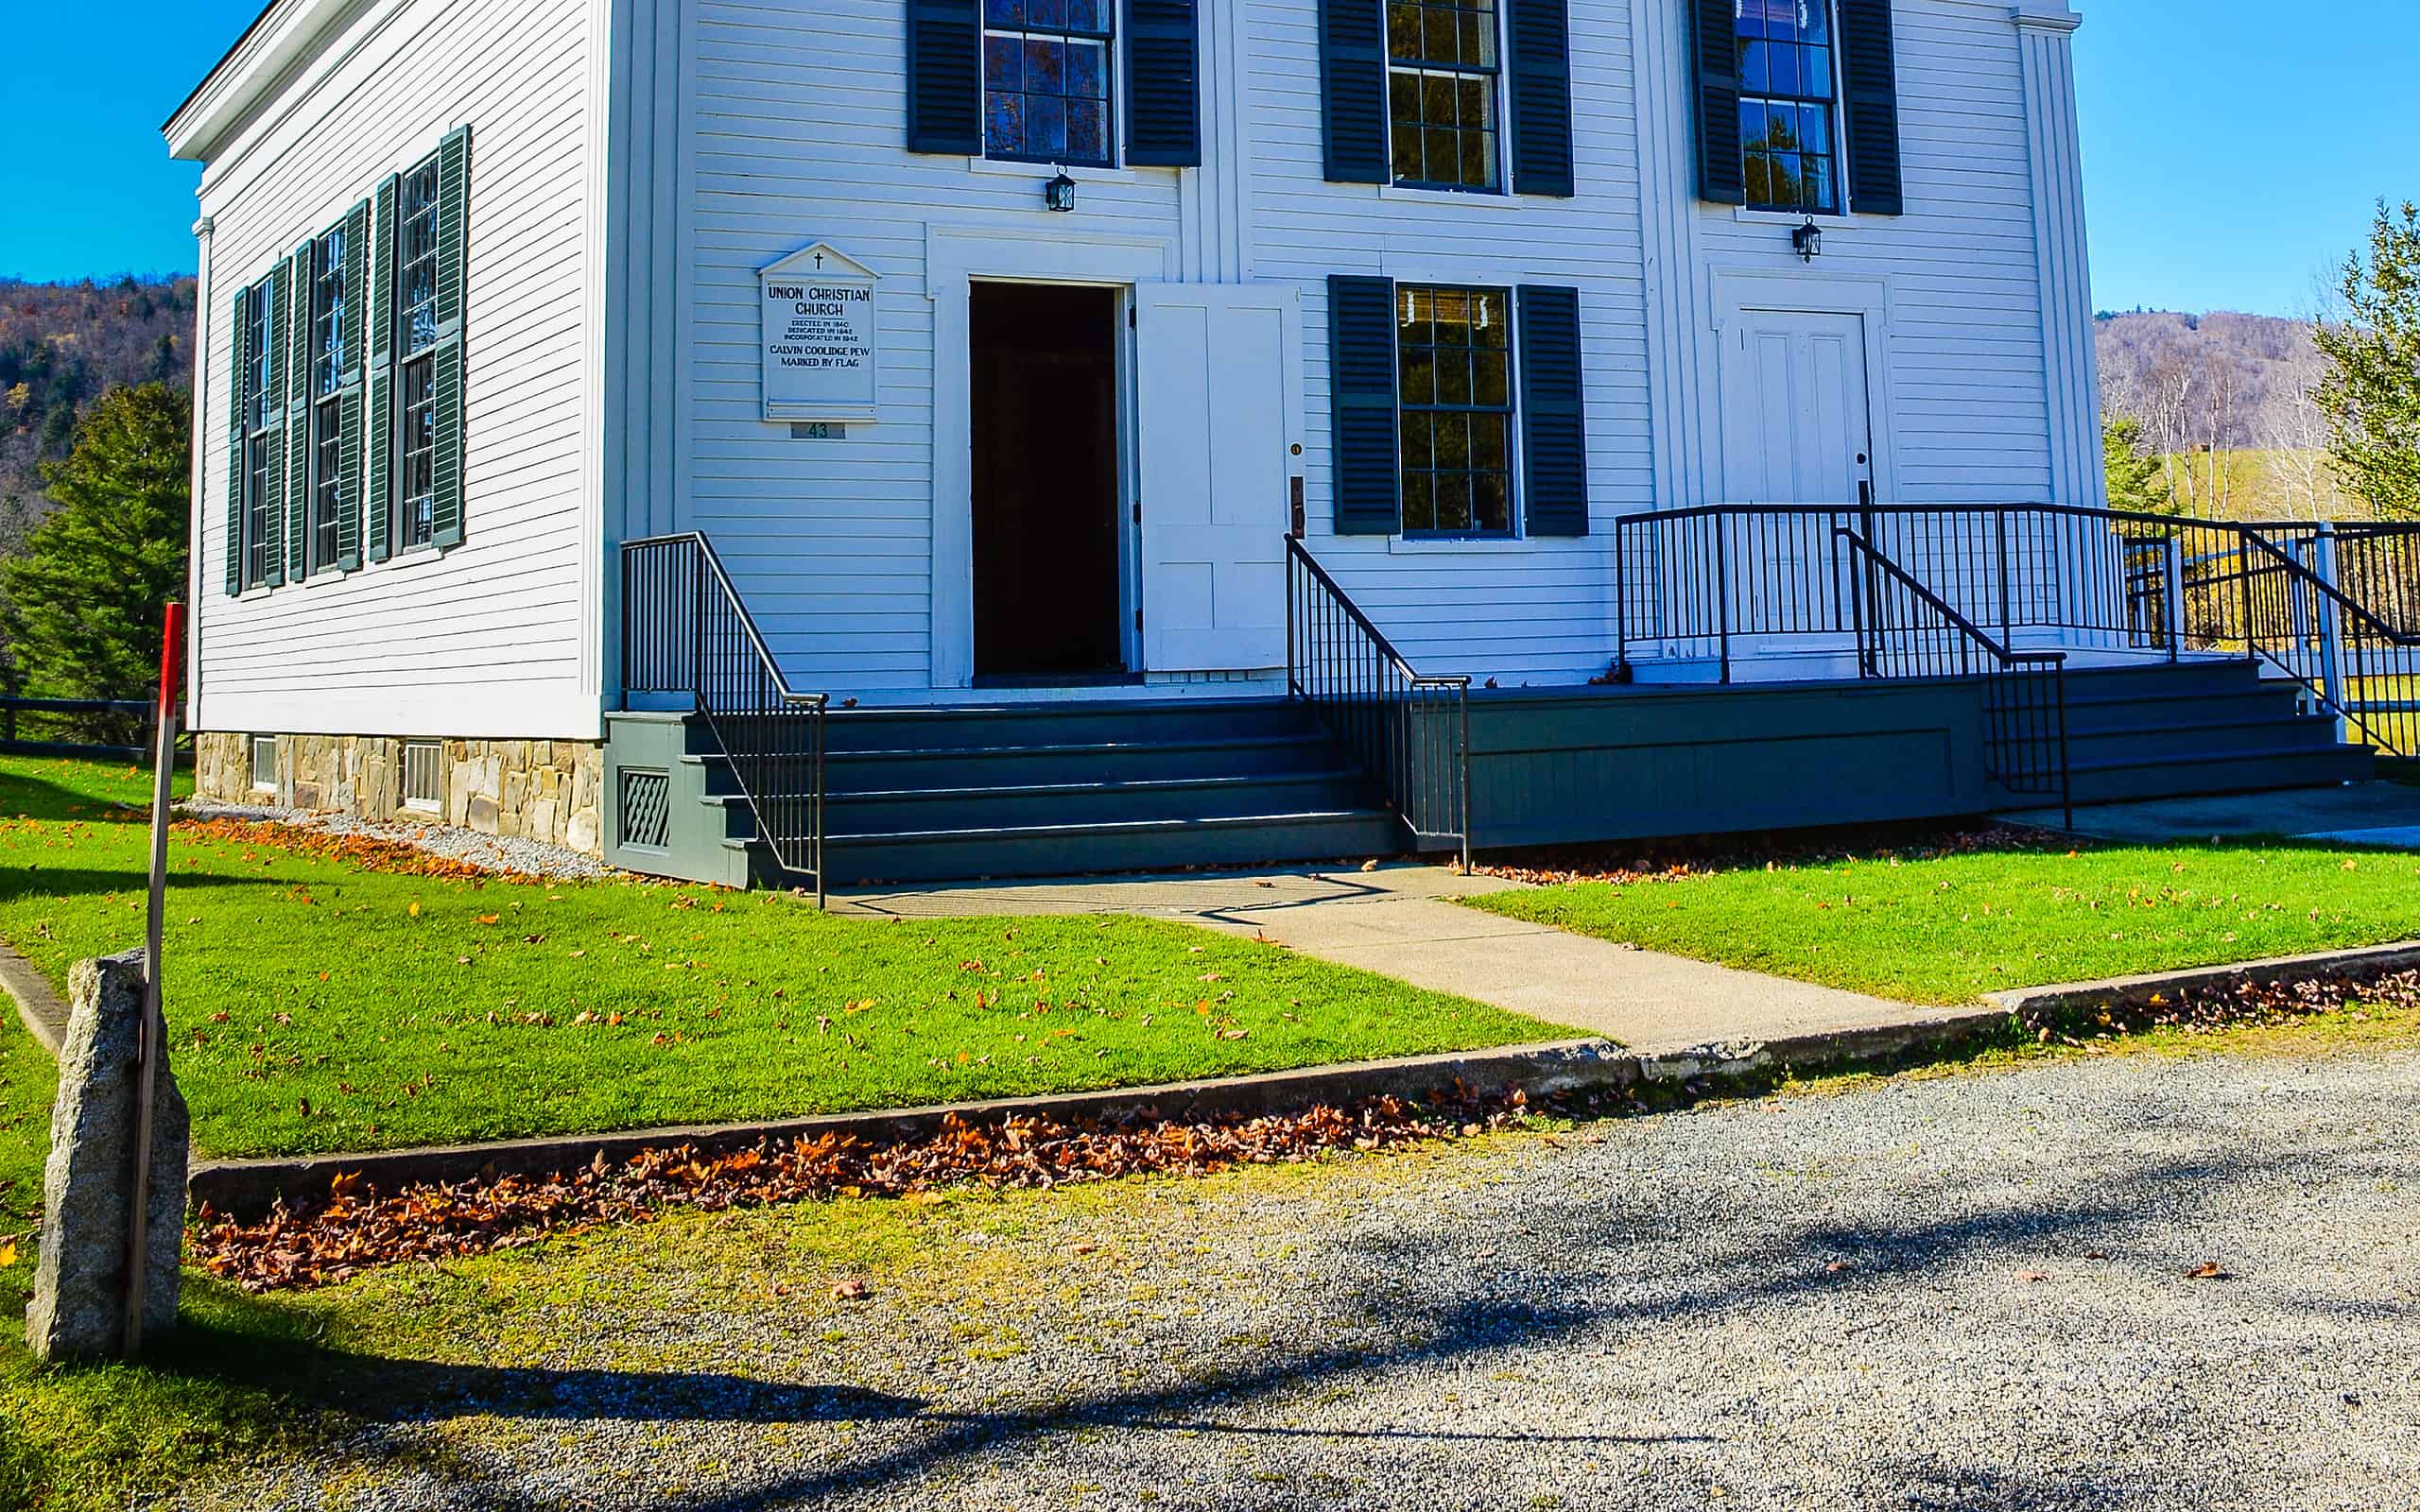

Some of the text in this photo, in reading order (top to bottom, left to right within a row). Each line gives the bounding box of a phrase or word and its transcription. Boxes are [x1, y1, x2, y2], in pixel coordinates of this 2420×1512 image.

[769, 286, 870, 301] UNION CHRISTIAN
[795, 302, 843, 316] CHURCH
[769, 345, 870, 356] CALVIN COOLIDGE PEW
[781, 358, 820, 367] MARKED
[836, 359, 859, 368] FLAG
[808, 423, 828, 438] 43
